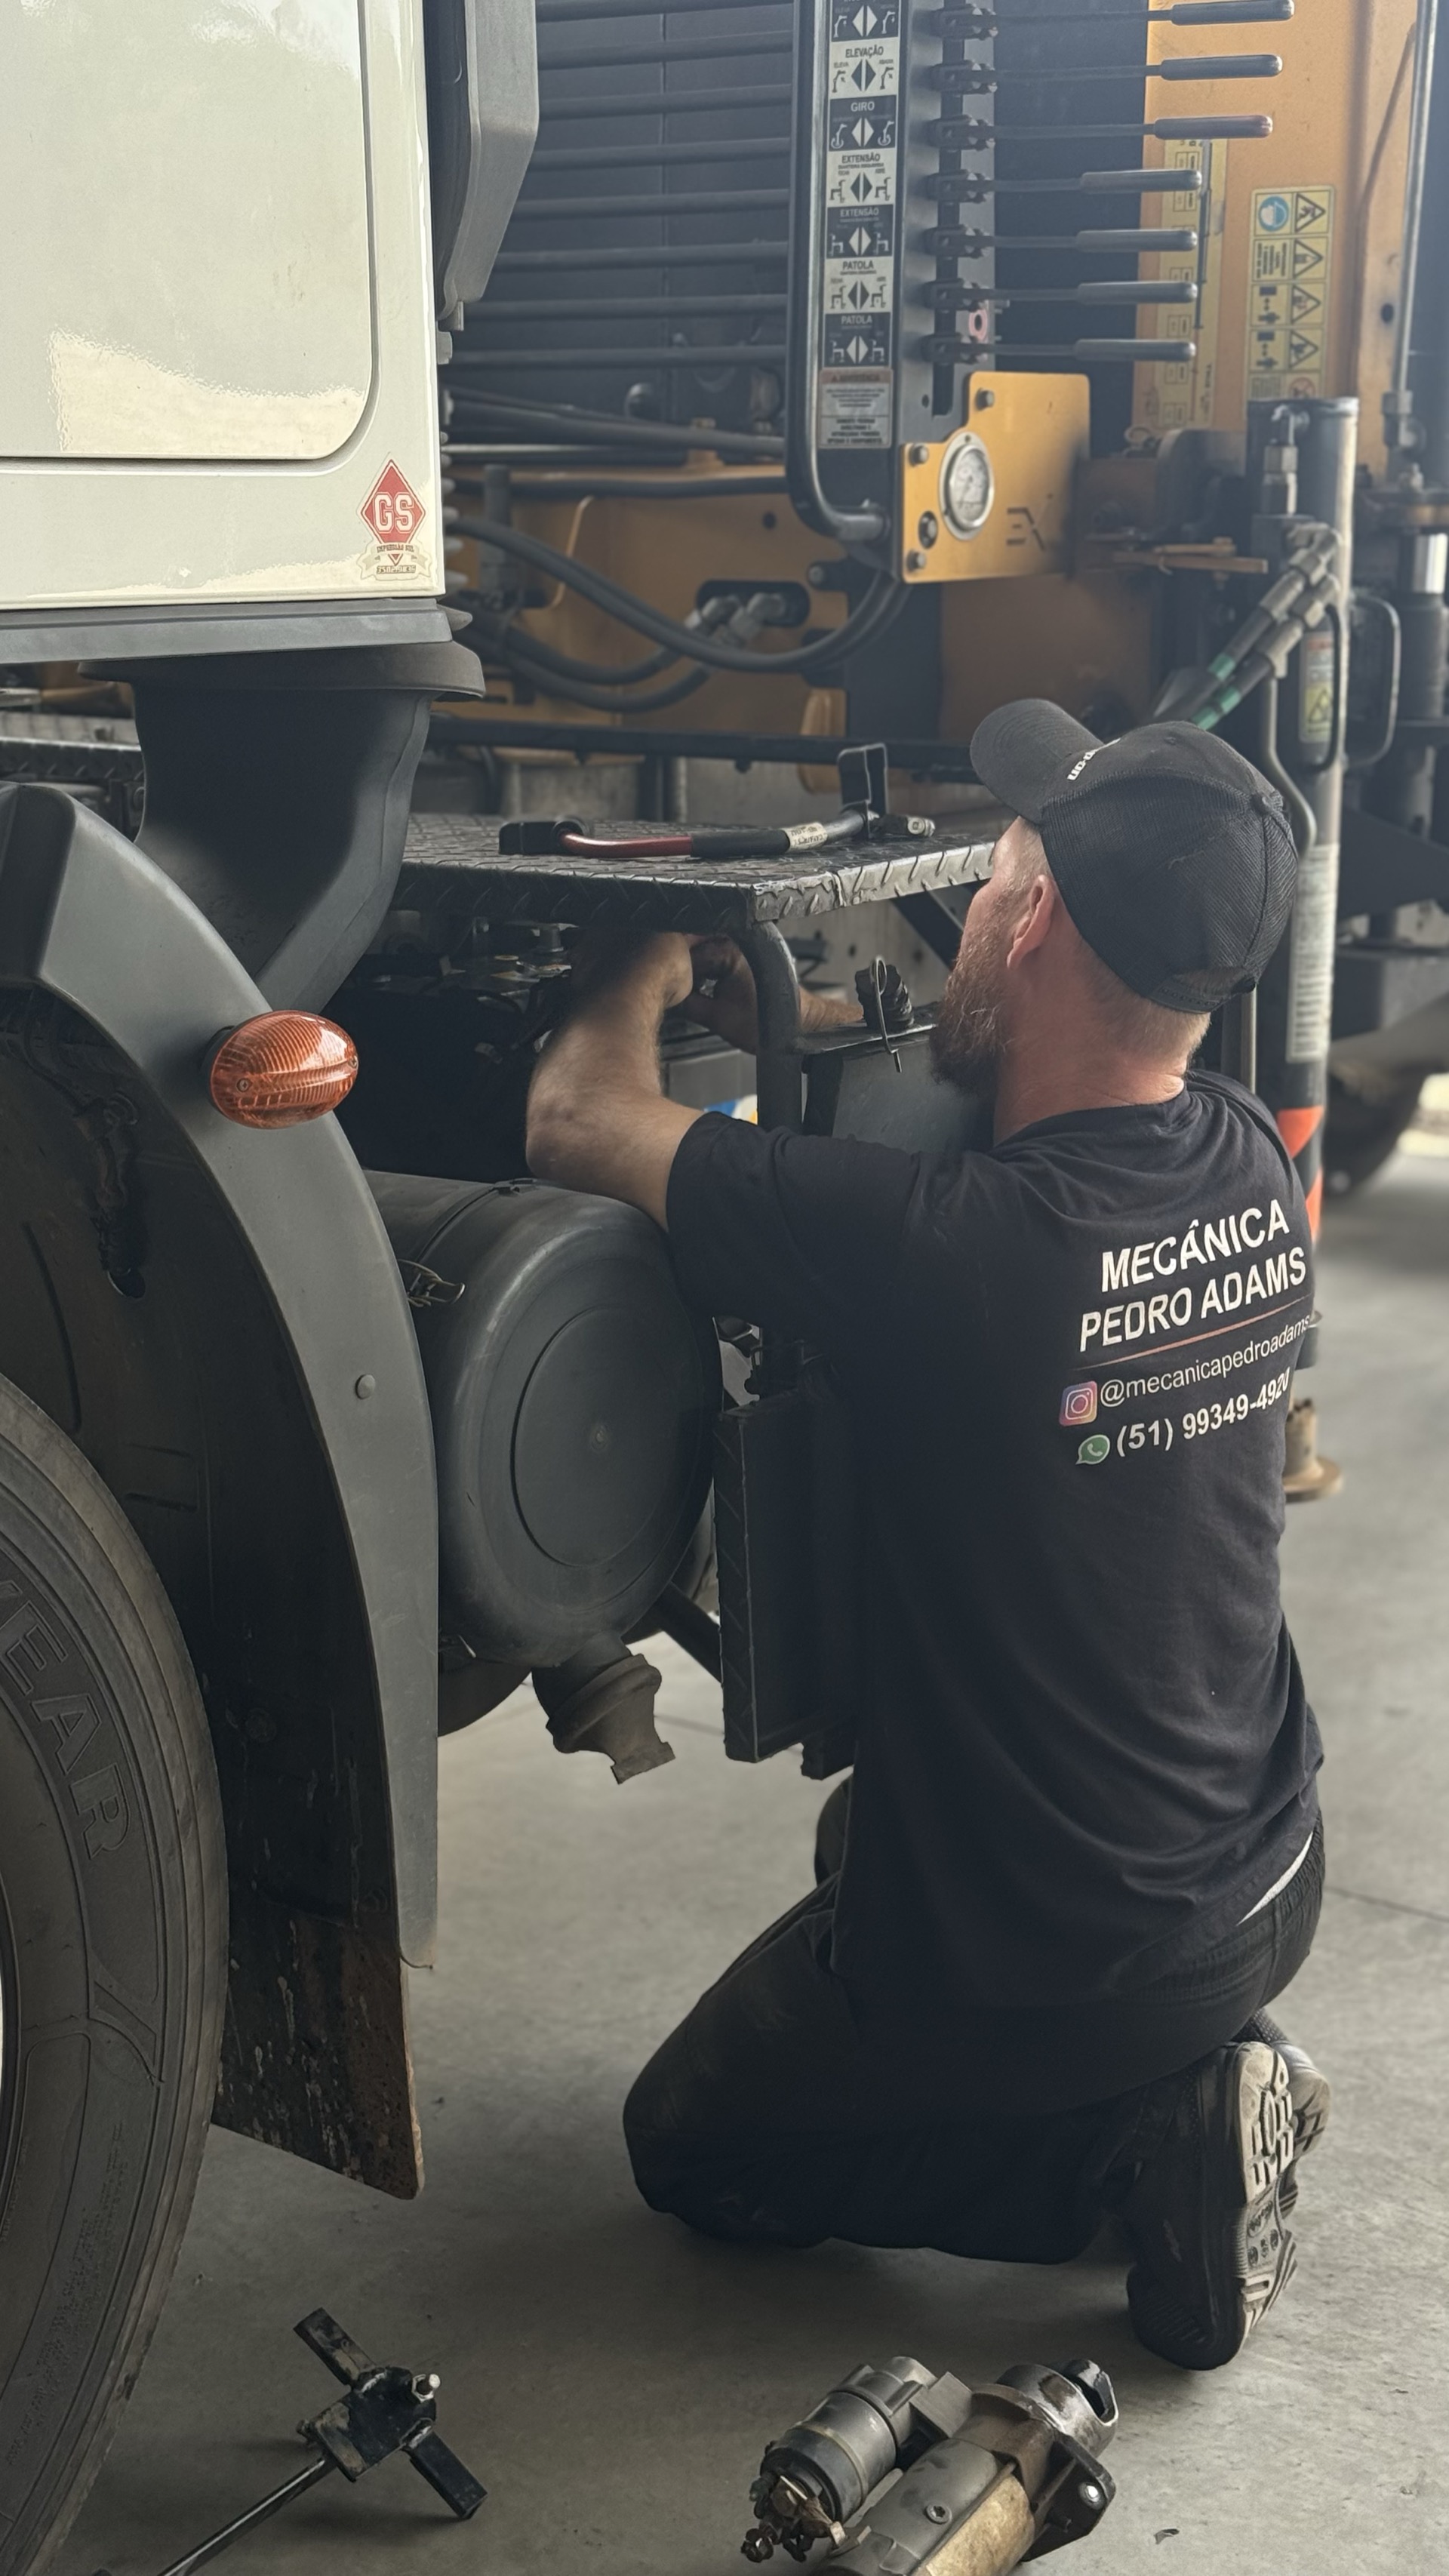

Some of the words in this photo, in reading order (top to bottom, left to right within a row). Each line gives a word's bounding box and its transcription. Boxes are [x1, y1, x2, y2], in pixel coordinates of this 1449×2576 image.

[845, 44, 884, 59] ELEVAÇÃO
[851, 101, 875, 112] GIRO
[841, 152, 881, 164] EXTENSÃO
[840, 206, 879, 218] EXTENSÃO
[842, 260, 874, 270] PATOLA
[841, 315, 872, 325] PATOLA
[374, 491, 415, 534] GS
[1101, 1199, 1290, 1293] MECÂNICA
[1079, 1287, 1192, 1353] PEDRO
[1200, 1246, 1307, 1319] ADAMS
[1116, 1418, 1174, 1457] (51)
[0, 1580, 131, 1860] EAR
